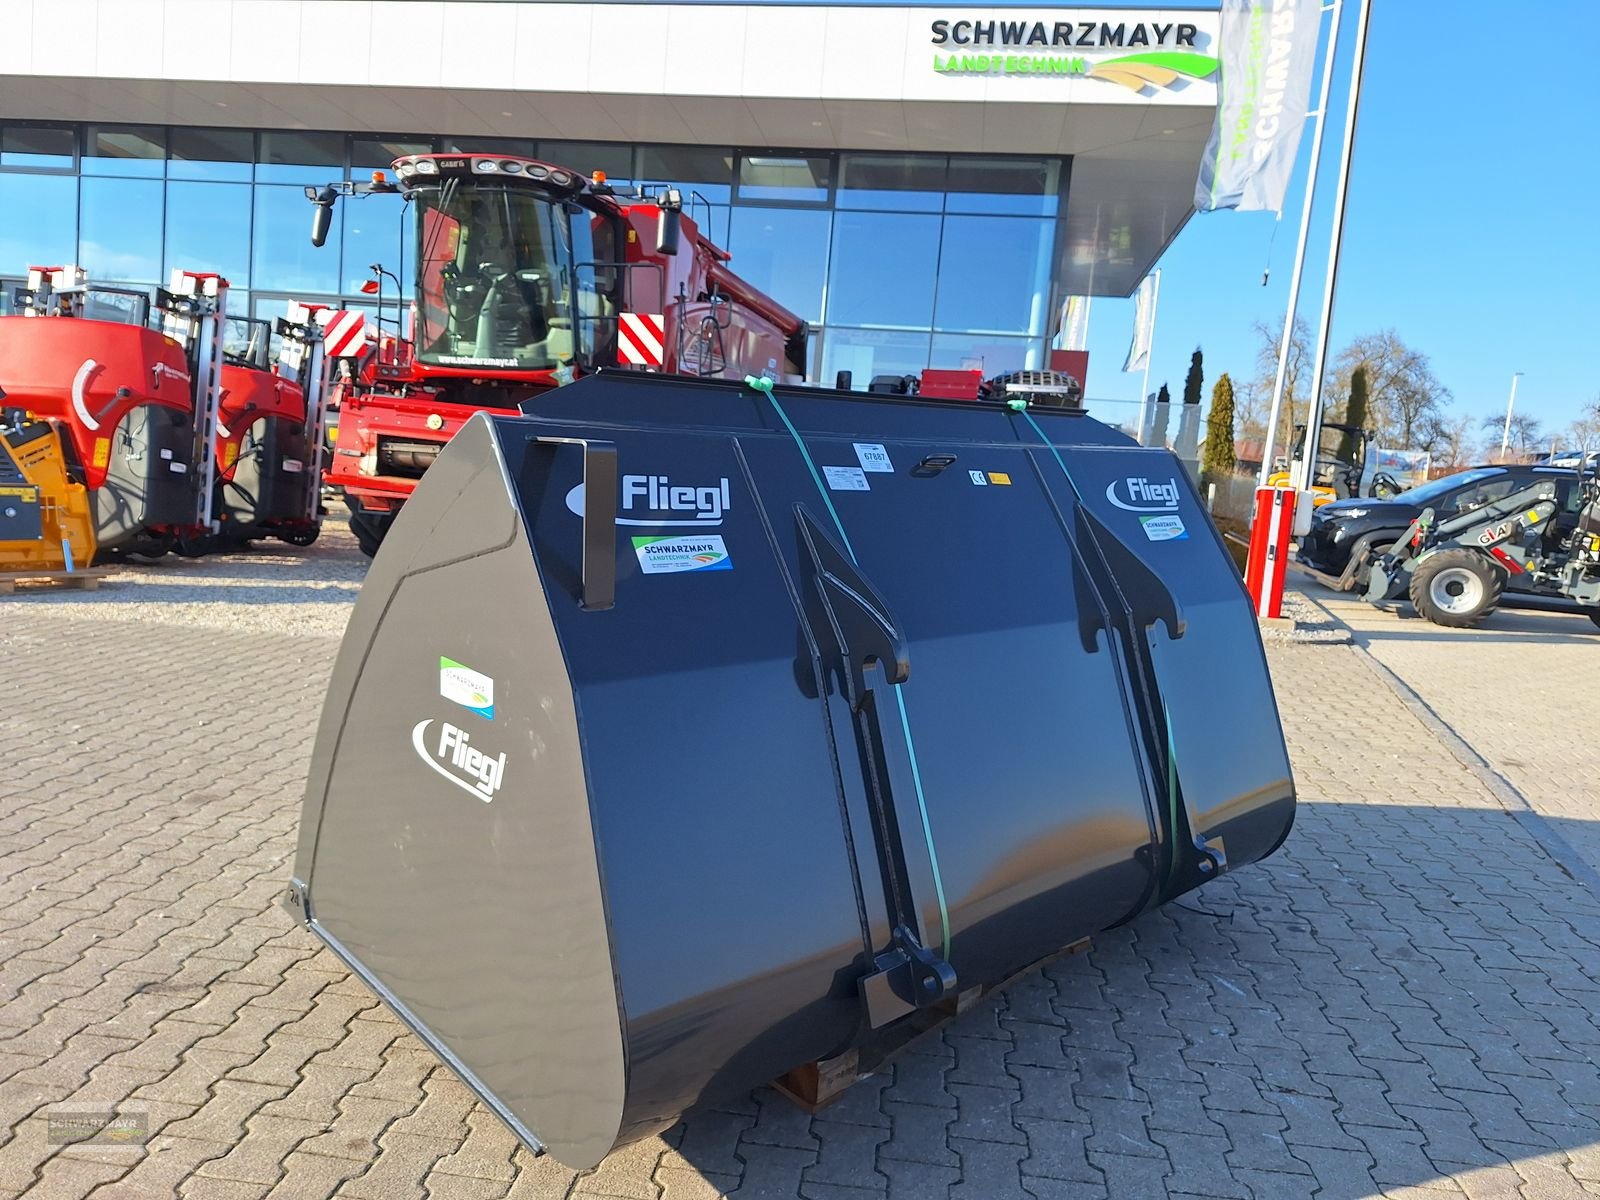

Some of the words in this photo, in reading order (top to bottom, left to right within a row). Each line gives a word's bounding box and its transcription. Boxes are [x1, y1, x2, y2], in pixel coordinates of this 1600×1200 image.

[931, 20, 1198, 47] SCHWARZMAYR
[933, 53, 1087, 74] LANDTECHNIK
[622, 474, 731, 518] Fliegl
[1126, 477, 1180, 506] Fliegl
[1478, 515, 1526, 546] GiAT
[644, 544, 714, 554] SCHWARZMAYR
[438, 722, 507, 796] Fliegl
